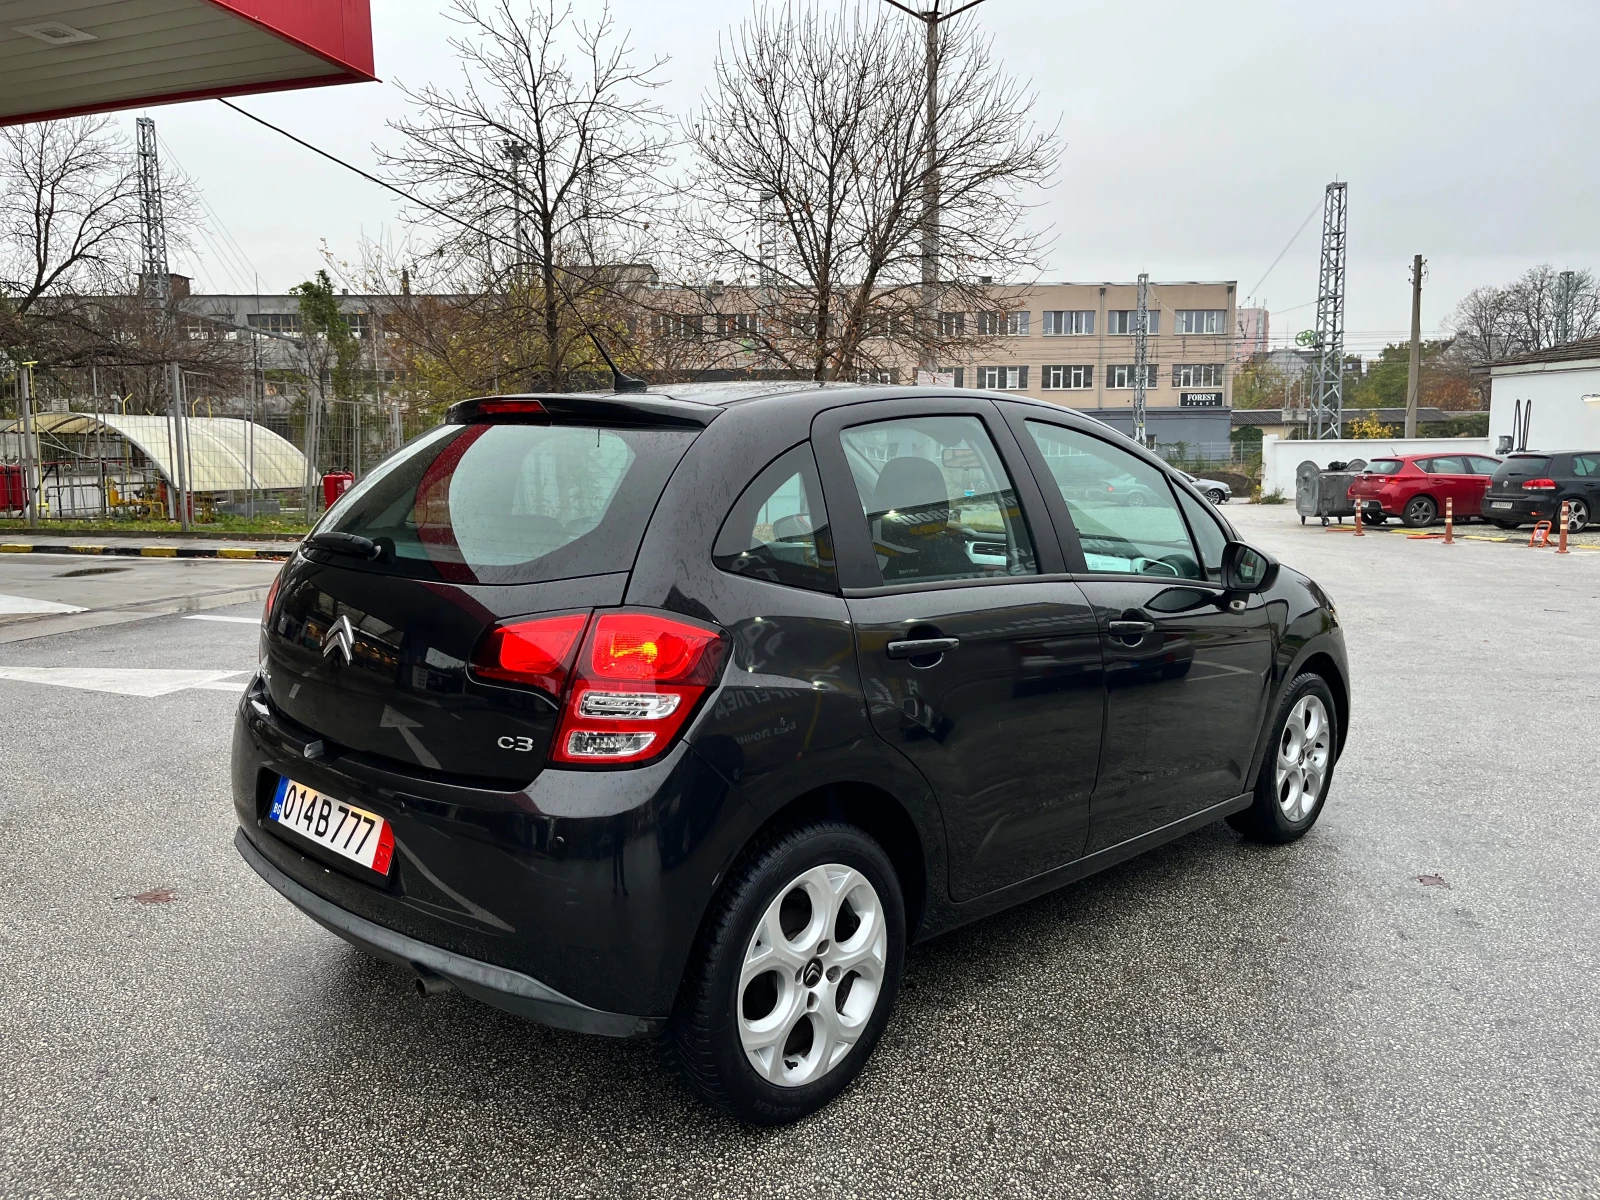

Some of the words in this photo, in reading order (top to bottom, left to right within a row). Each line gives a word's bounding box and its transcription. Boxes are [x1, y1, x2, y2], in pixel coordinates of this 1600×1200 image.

[497, 736, 534, 752] C3
[273, 802, 282, 815] BG
[753, 1098, 802, 1117] NEXEN
